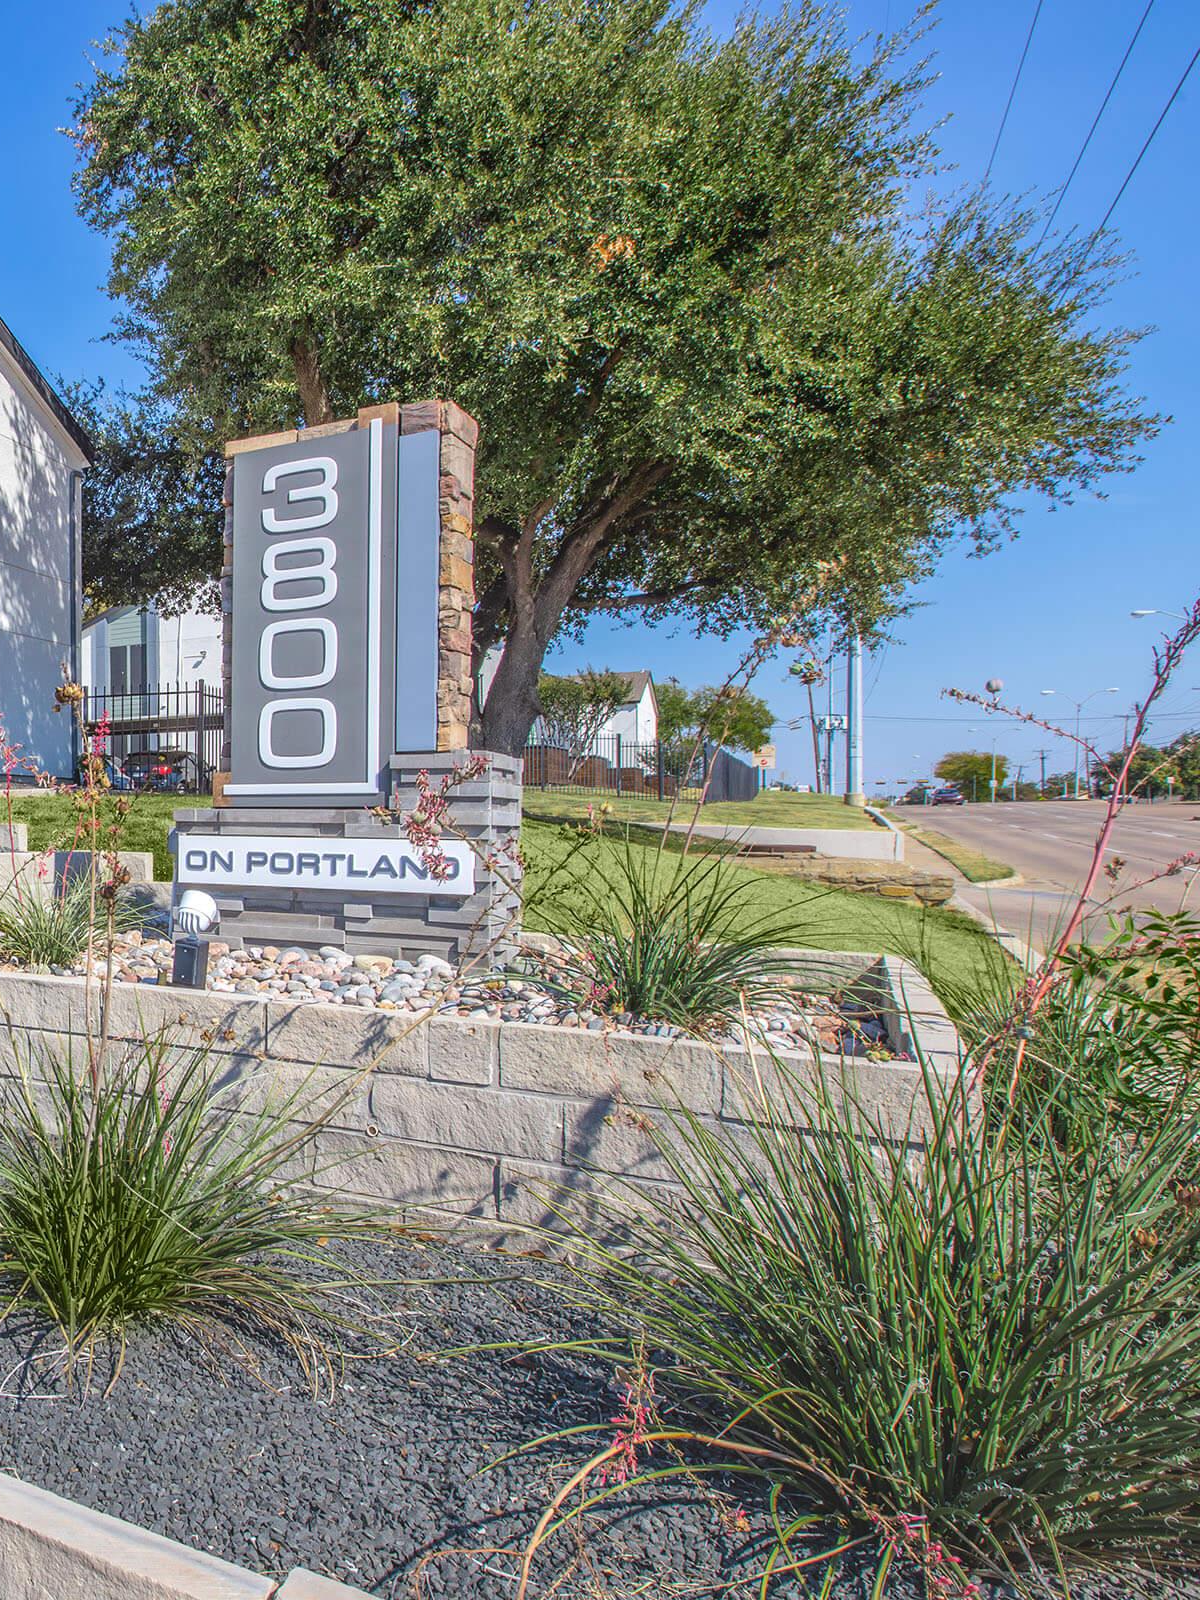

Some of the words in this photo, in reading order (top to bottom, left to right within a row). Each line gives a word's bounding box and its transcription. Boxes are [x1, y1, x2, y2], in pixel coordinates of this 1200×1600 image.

[259, 456, 338, 769] 3800
[185, 850, 234, 874] ON
[246, 851, 460, 881] PORTLAND
